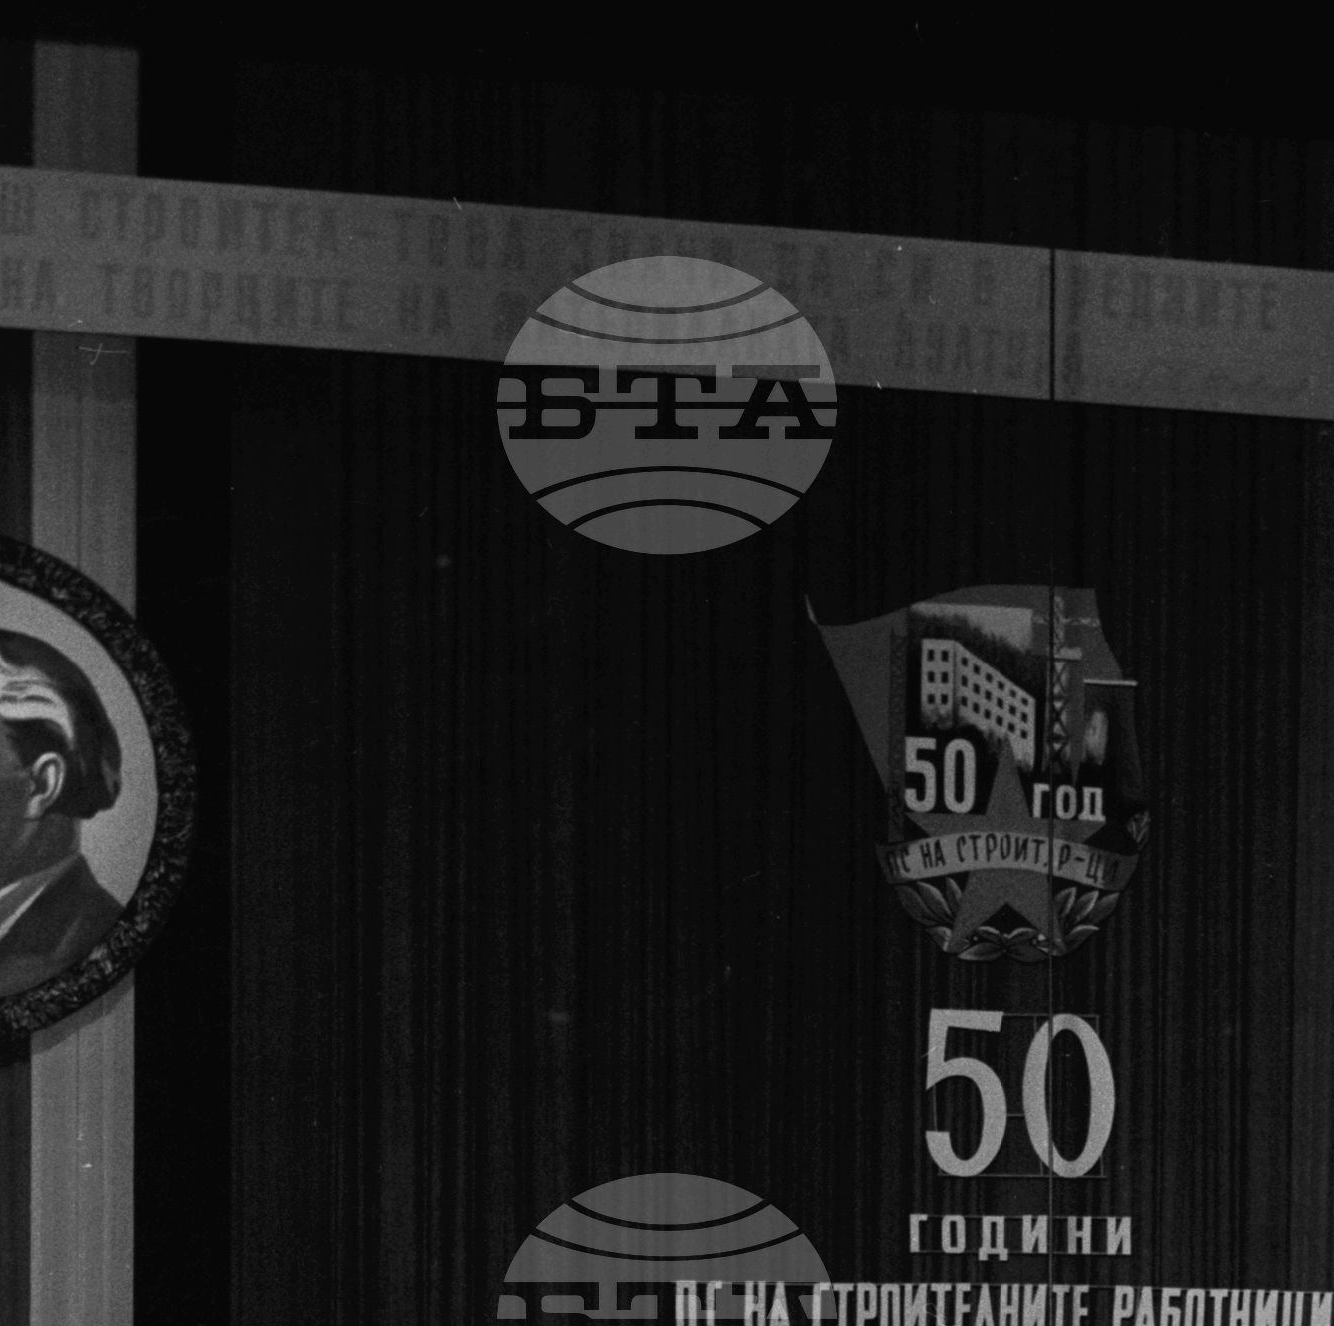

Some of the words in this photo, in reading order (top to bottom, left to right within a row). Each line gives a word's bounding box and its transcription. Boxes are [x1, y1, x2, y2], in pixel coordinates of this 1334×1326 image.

[1, 256, 57, 313] НА
[97, 262, 355, 337] ТВОРЦИТЕ
[397, 282, 454, 337] НА
[905, 736, 977, 813] 50
[919, 839, 947, 869] НА
[925, 1007, 1116, 1178] 50
[910, 1214, 1132, 1260] ГОДИНИ
